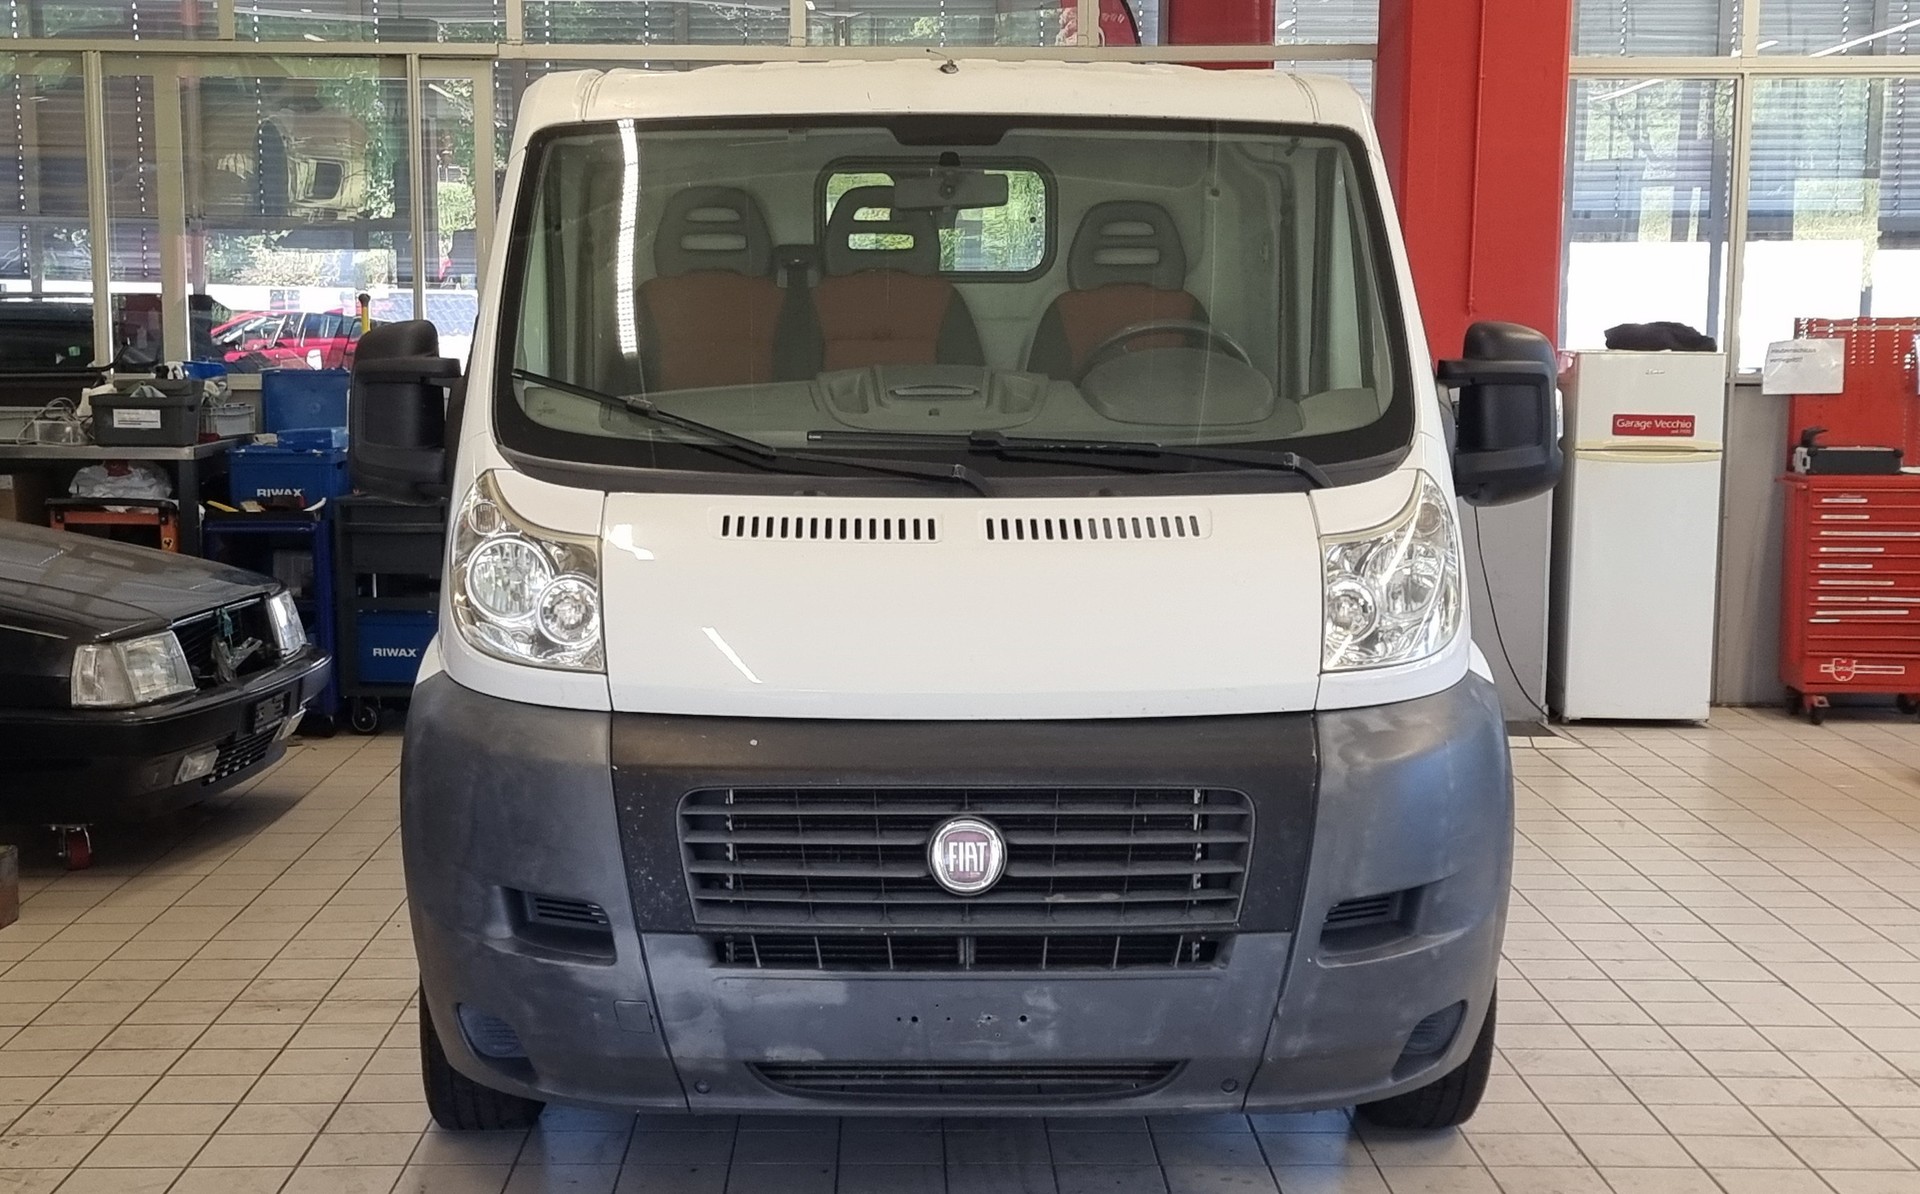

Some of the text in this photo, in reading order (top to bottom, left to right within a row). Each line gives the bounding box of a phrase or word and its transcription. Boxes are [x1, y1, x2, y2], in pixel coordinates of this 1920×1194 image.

[1616, 418, 1692, 430] Garage Vecchio
[256, 488, 302, 498] RIWAX
[372, 647, 417, 658] RIWAX
[948, 841, 988, 872] FIAT
